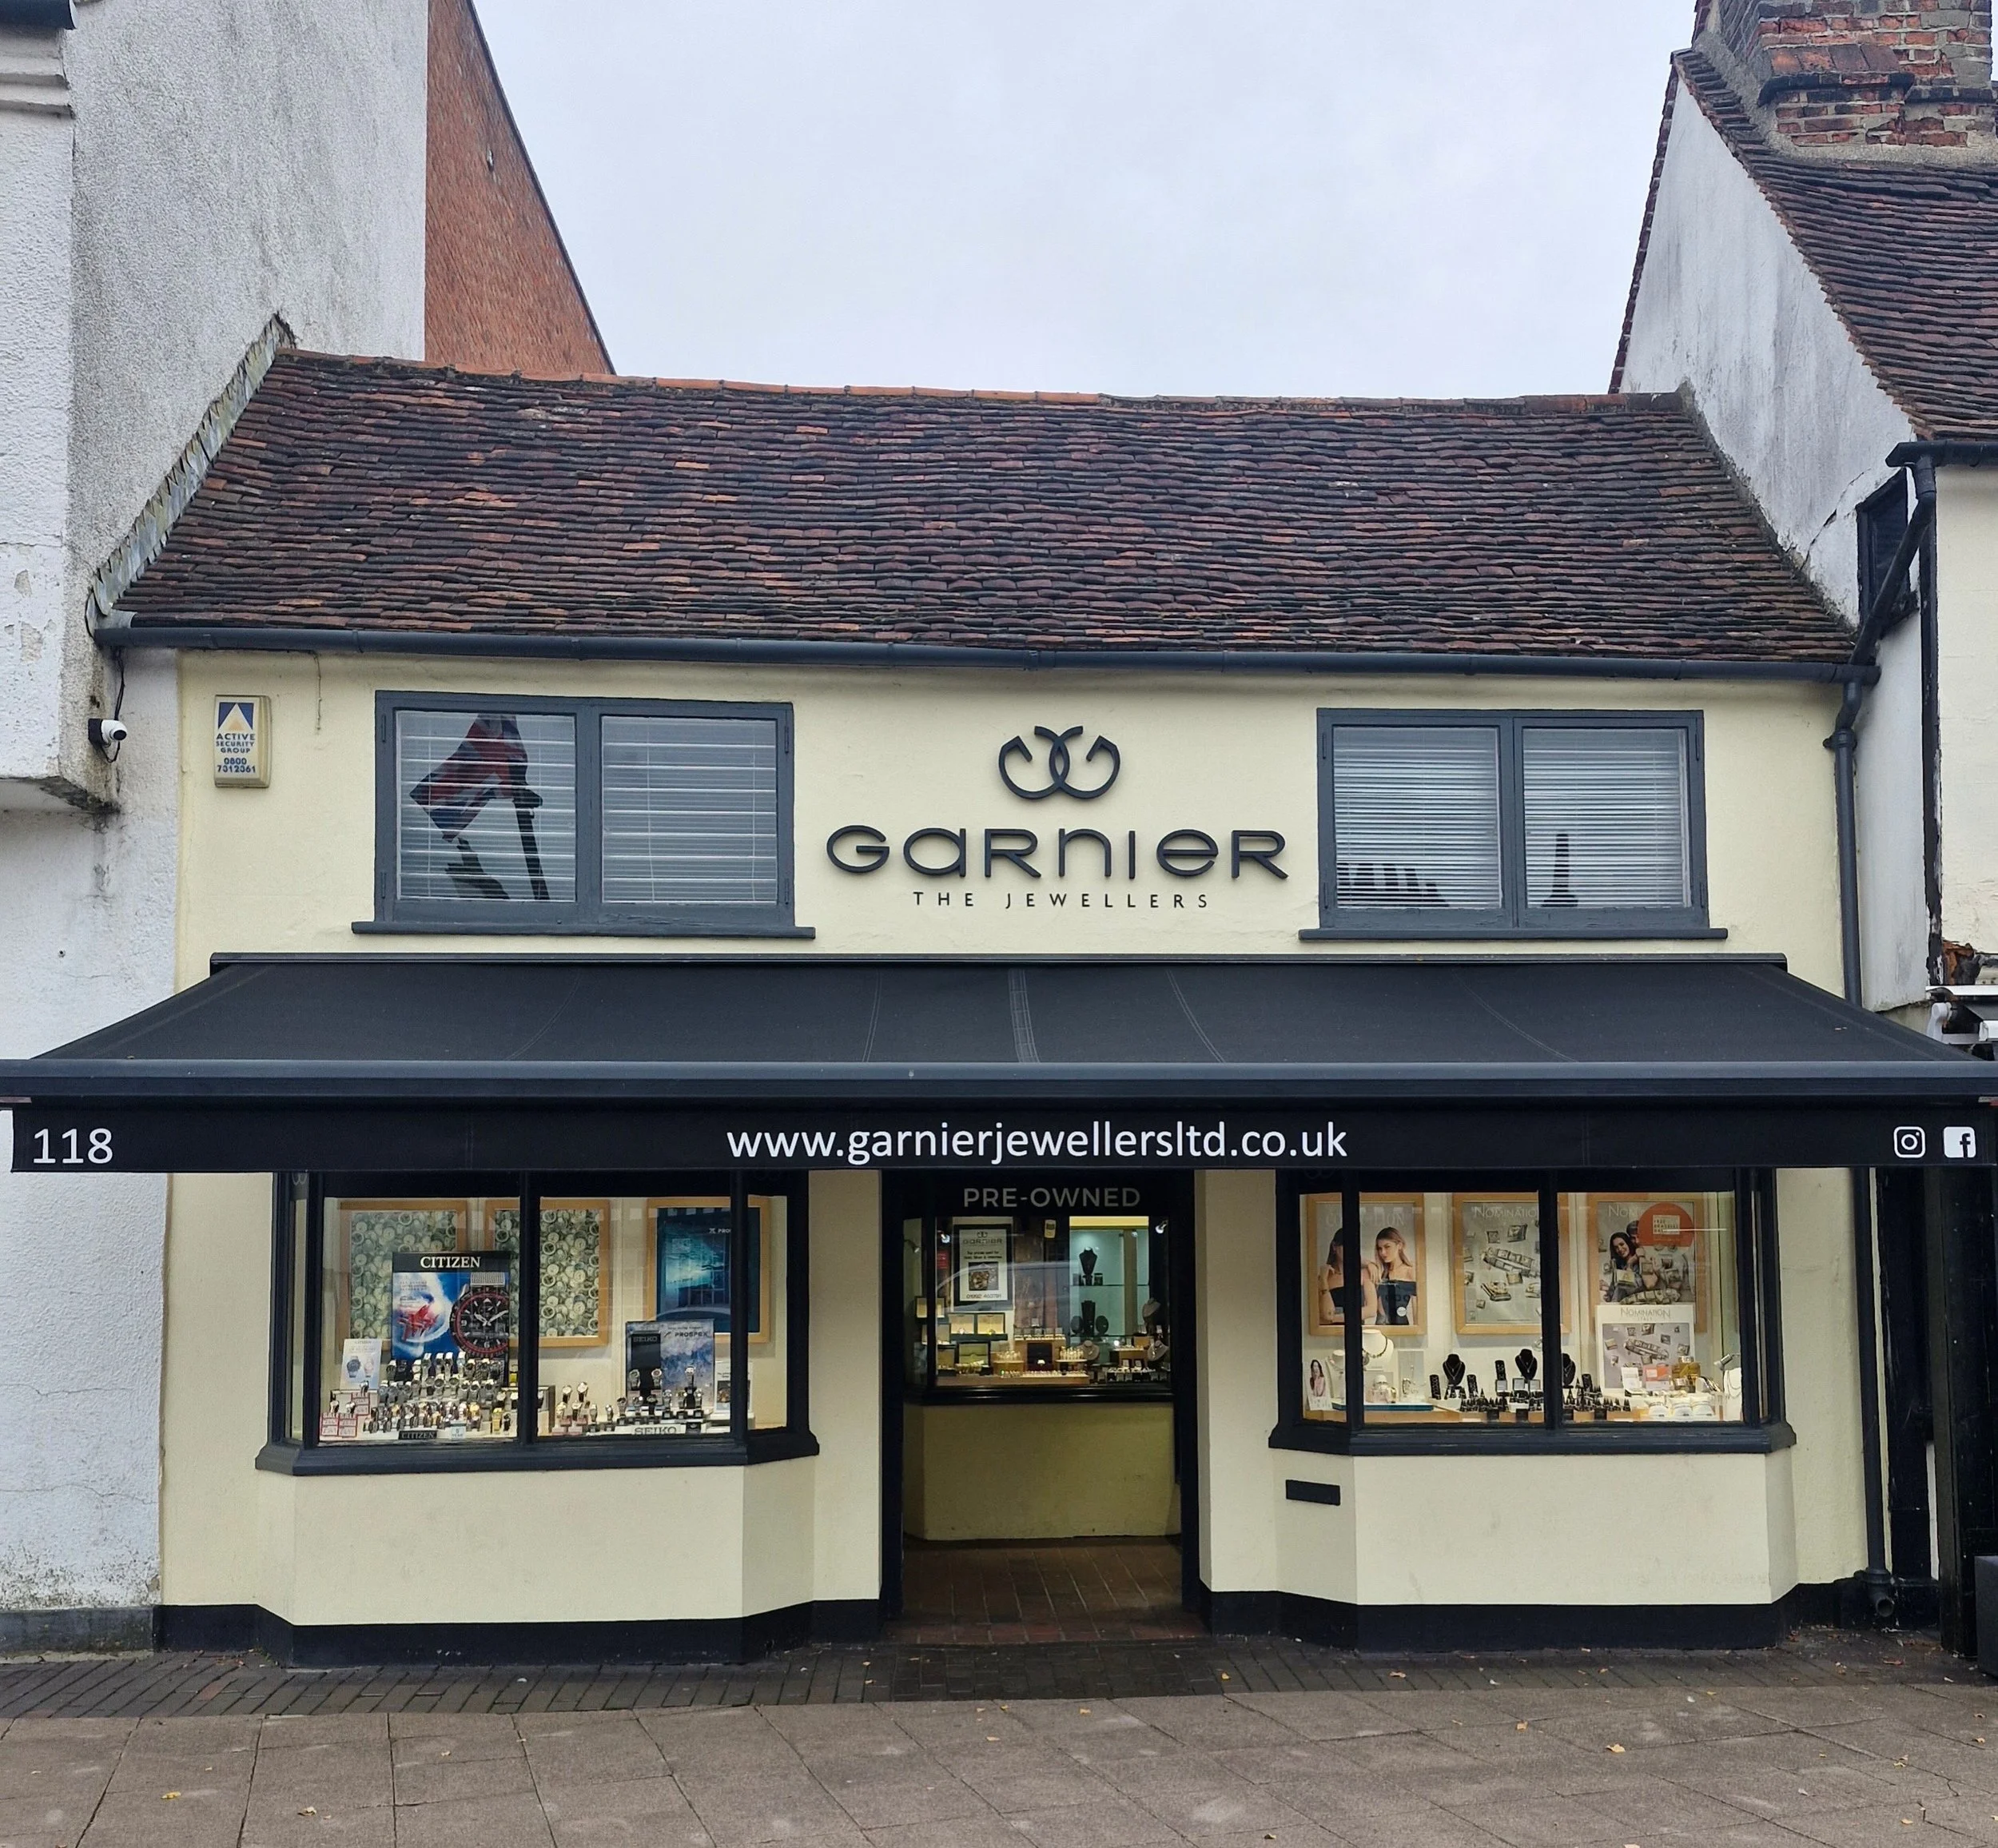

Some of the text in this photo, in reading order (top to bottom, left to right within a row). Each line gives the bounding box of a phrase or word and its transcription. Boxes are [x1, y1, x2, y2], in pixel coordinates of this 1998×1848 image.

[913, 891, 1208, 910] THE JEWELLERS
[33, 1128, 113, 1165] 118
[726, 1121, 1348, 1165] www.garnierjewellersltd.co.uk
[963, 1188, 1141, 1208] PRE-OWNED
[1473, 1205, 1538, 1219] NOMINATIO
[420, 1256, 481, 1269] CITIZEN
[1620, 1307, 1670, 1320] NOMINATION
[635, 1426, 677, 1435] SEIKO
